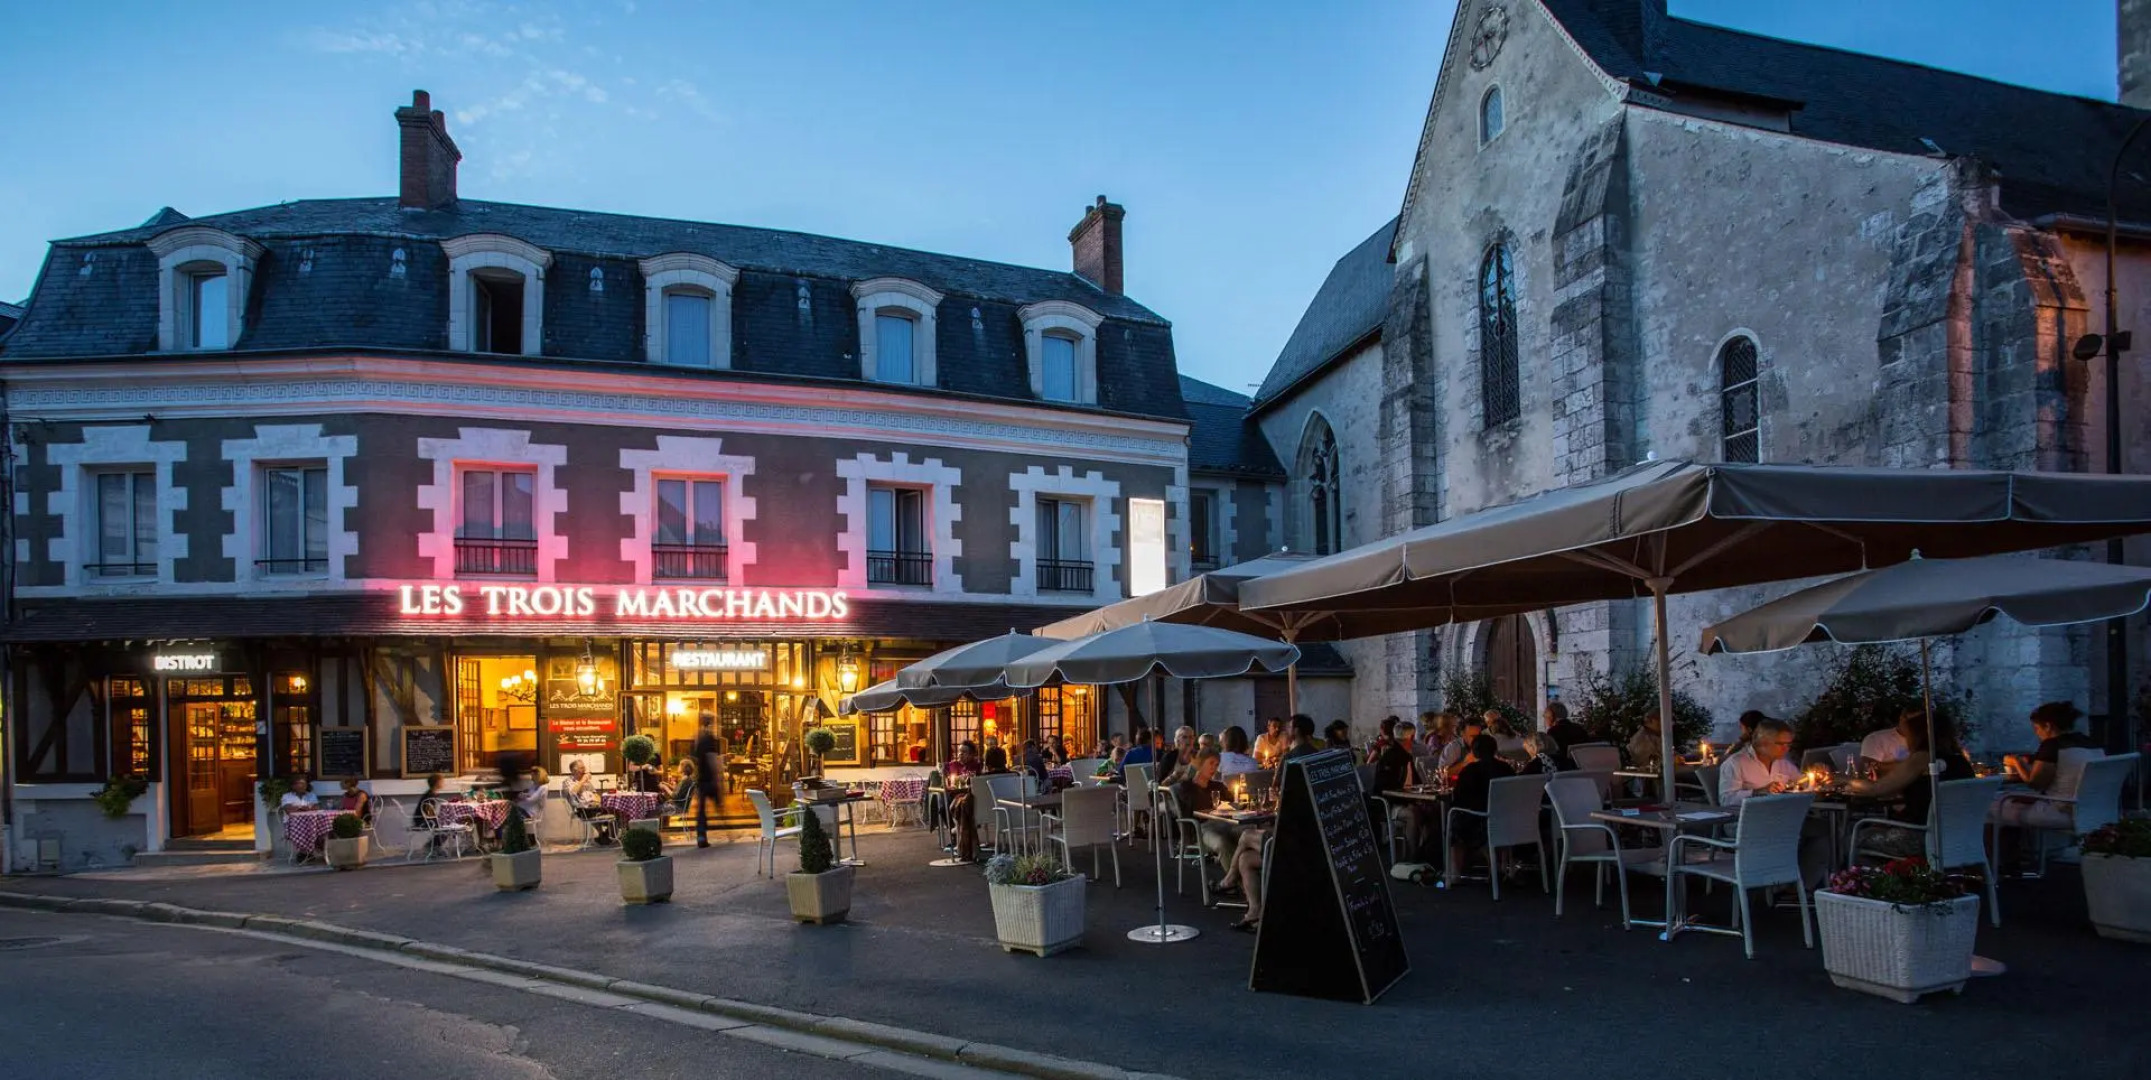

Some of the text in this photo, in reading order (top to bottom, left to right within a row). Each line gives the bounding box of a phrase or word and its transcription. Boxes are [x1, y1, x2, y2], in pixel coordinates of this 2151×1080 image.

[400, 585, 848, 618] LES TROIS MARCHANDS
[154, 655, 215, 670] BISTROT
[672, 651, 766, 667] RESTAURANT
